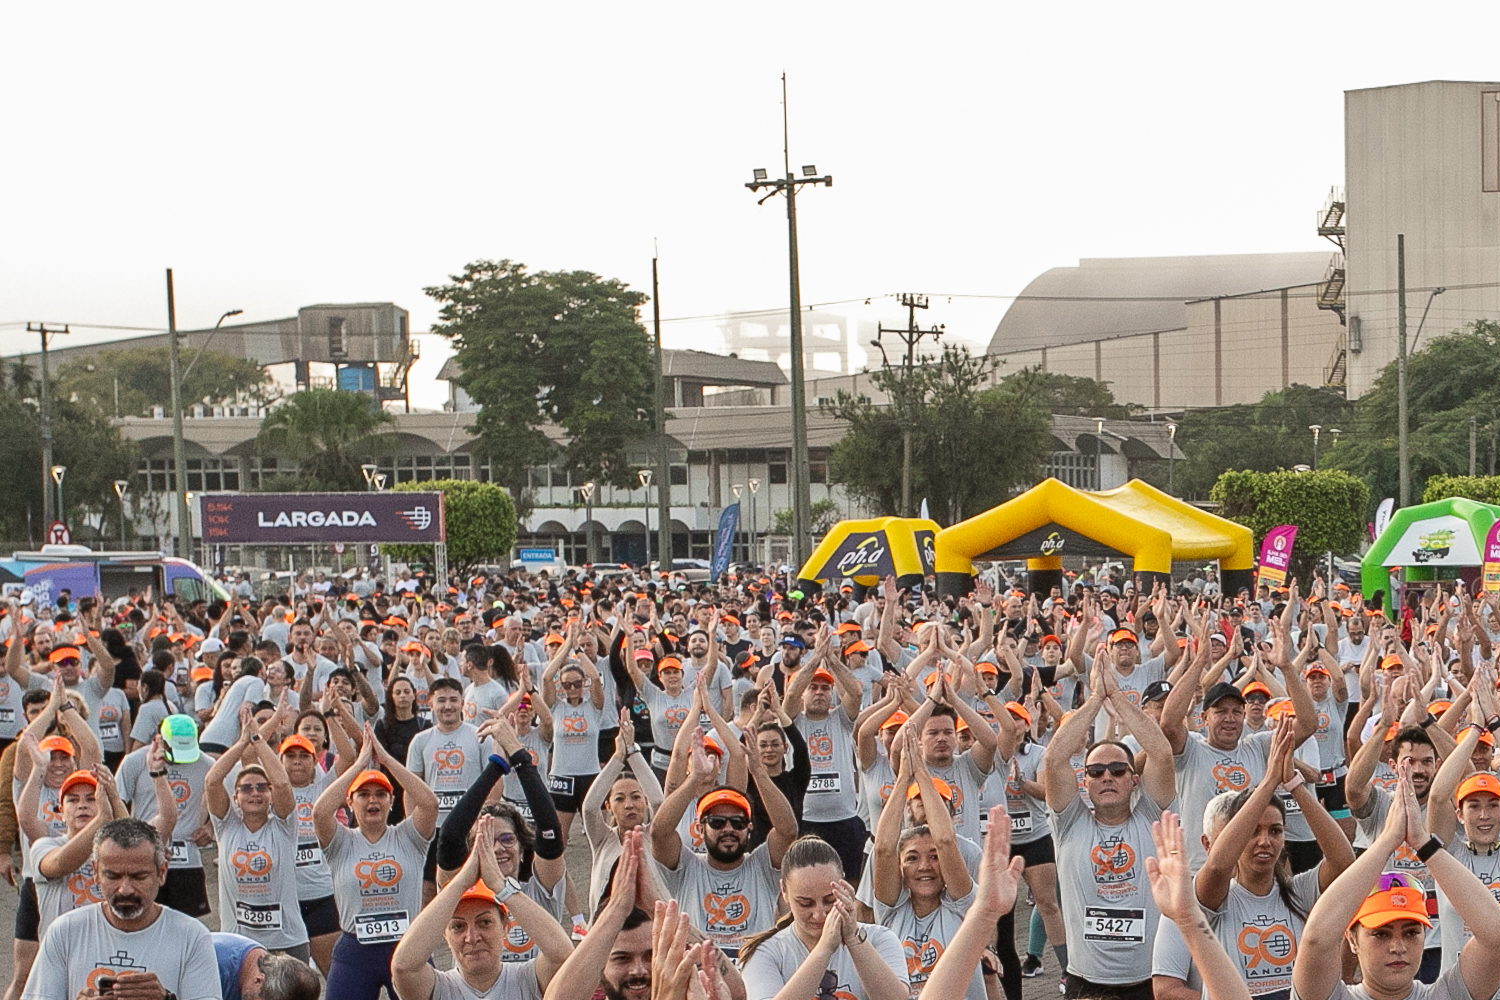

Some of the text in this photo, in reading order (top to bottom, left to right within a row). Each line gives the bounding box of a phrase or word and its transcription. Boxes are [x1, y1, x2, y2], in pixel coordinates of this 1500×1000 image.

[258, 511, 377, 527] LARGADA
[1041, 538, 1065, 551] ph.d
[523, 551, 554, 561] ENTRADA
[838, 546, 884, 570] ph.d
[563, 716, 587, 731] 90
[809, 736, 833, 756] 90
[435, 749, 464, 770] 90
[813, 779, 835, 789] 5788
[232, 851, 272, 876] 90
[1091, 843, 1135, 875] 90
[355, 859, 402, 889] 90
[1099, 872, 1132, 880] ANOS
[244, 910, 272, 922] 6296
[704, 892, 750, 926] 90
[365, 921, 399, 935] 6913
[1096, 918, 1133, 933] 5427
[1237, 924, 1298, 969] 90
[1250, 966, 1293, 976] ANOS
